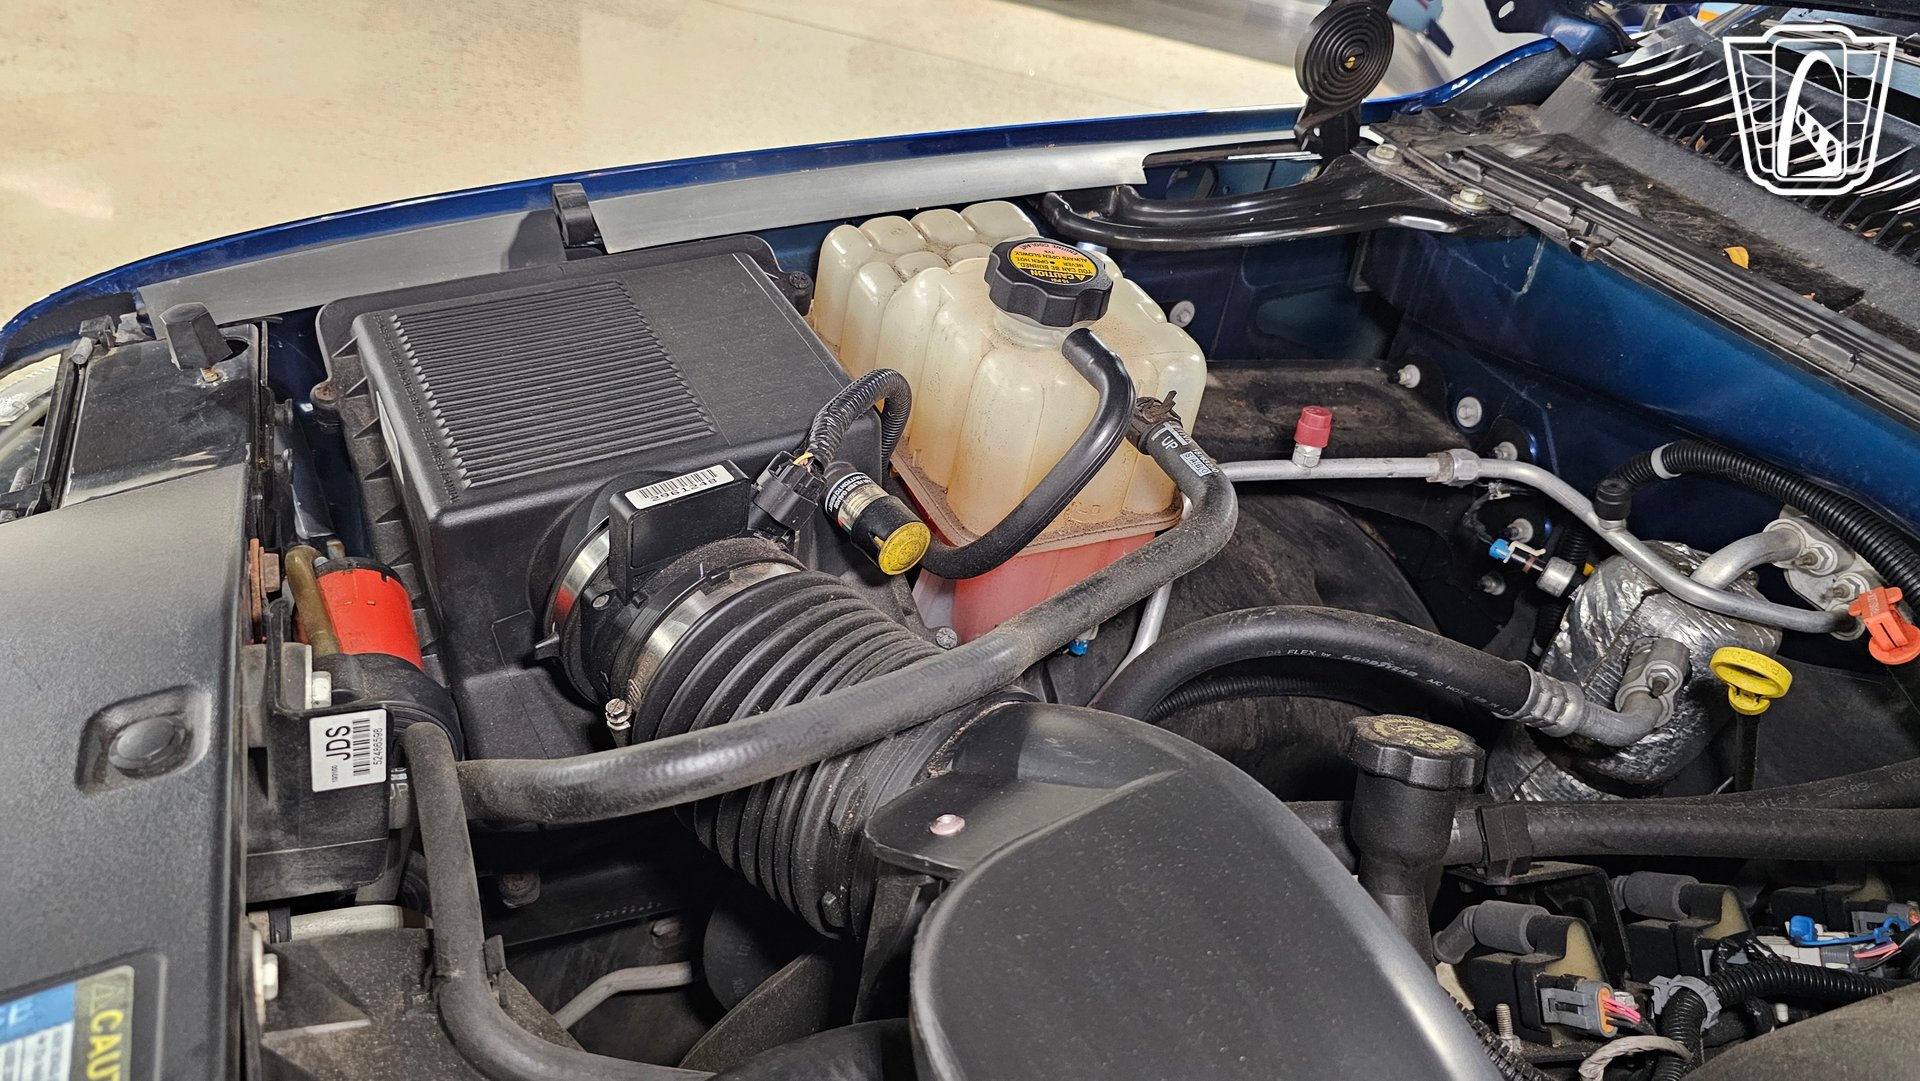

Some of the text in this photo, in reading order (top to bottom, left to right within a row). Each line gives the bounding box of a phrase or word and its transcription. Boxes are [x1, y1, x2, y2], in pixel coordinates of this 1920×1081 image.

[1030, 269, 1075, 280] CAUTION
[1162, 436, 1178, 450] UP
[650, 478, 718, 502] 2961248
[1342, 654, 1418, 677] GOODYEAR
[325, 726, 351, 760] JDS
[1403, 738, 1424, 747] OIL
